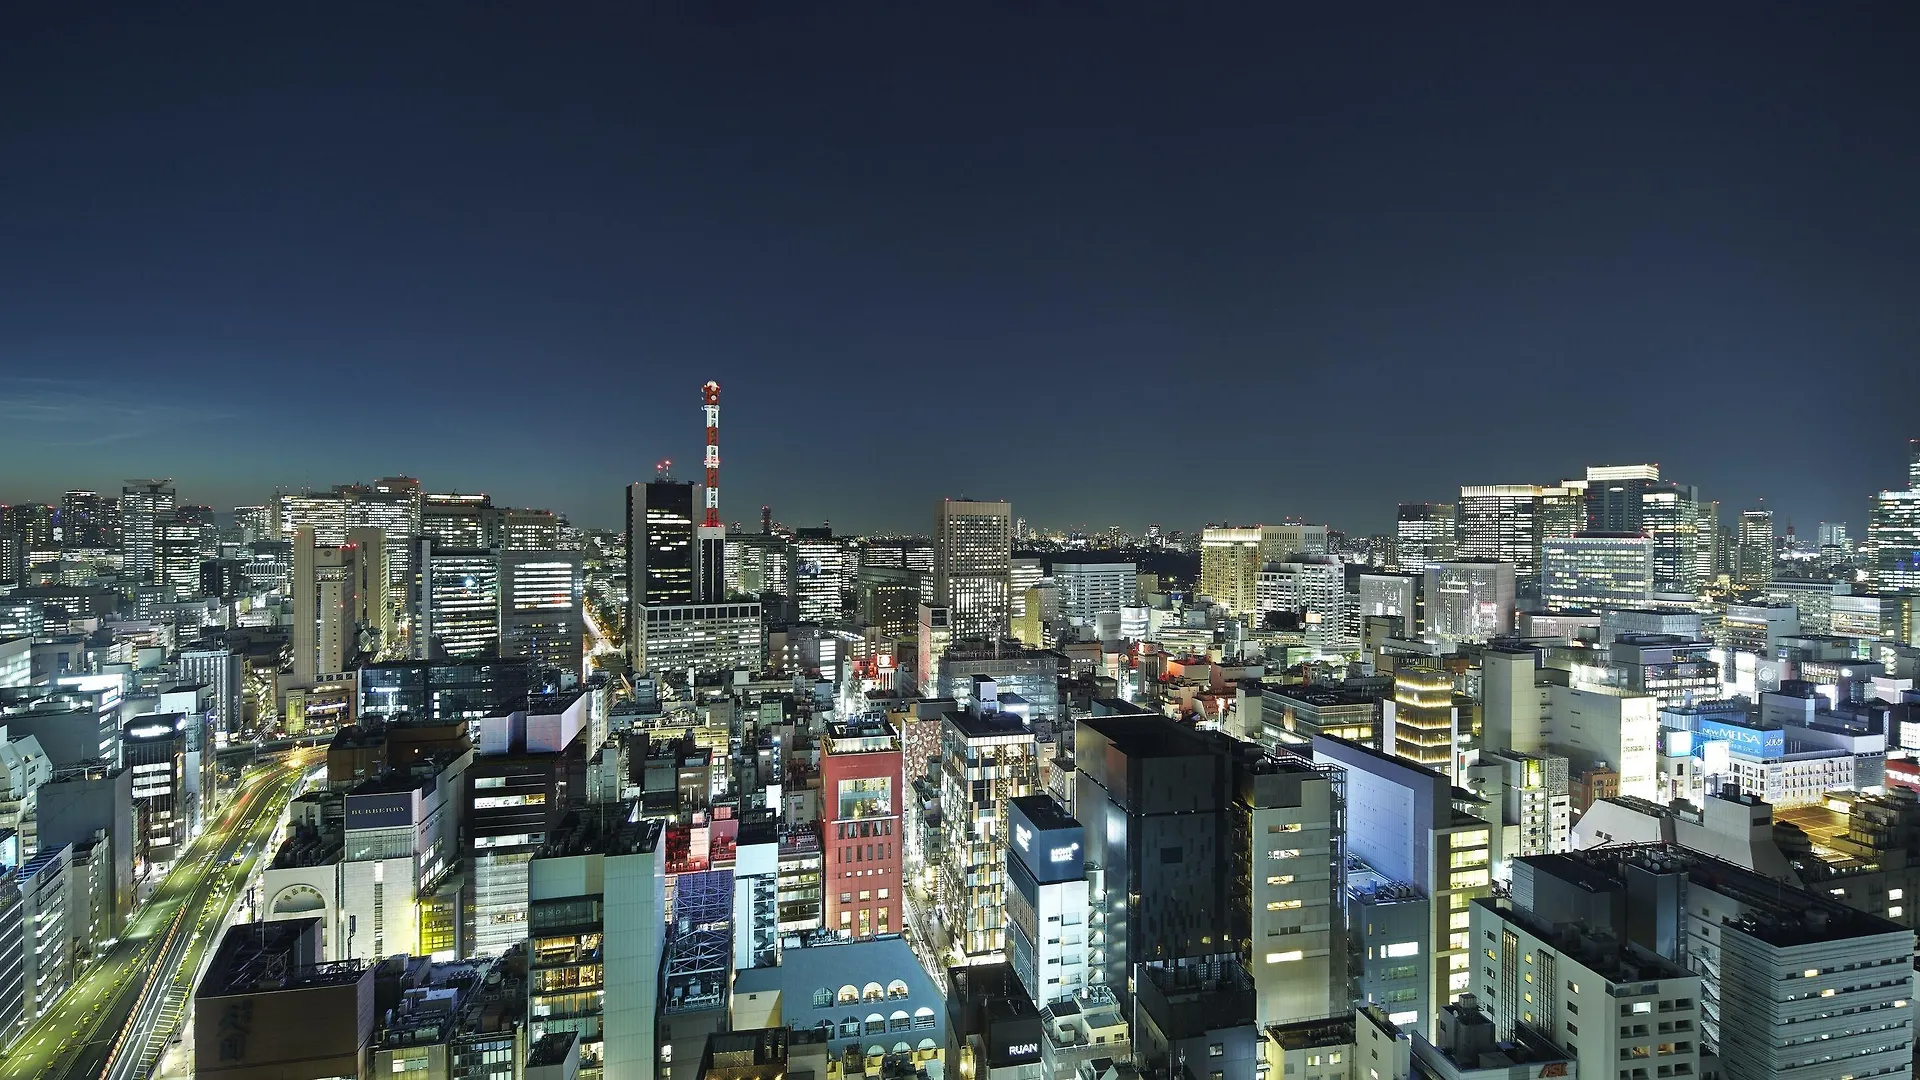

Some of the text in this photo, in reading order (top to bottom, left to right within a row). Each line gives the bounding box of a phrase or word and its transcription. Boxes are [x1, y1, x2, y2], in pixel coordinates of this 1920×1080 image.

[1719, 728, 1760, 744] MELSA
[351, 806, 405, 815] BURBERRY
[1009, 1043, 1038, 1055] RUAN
